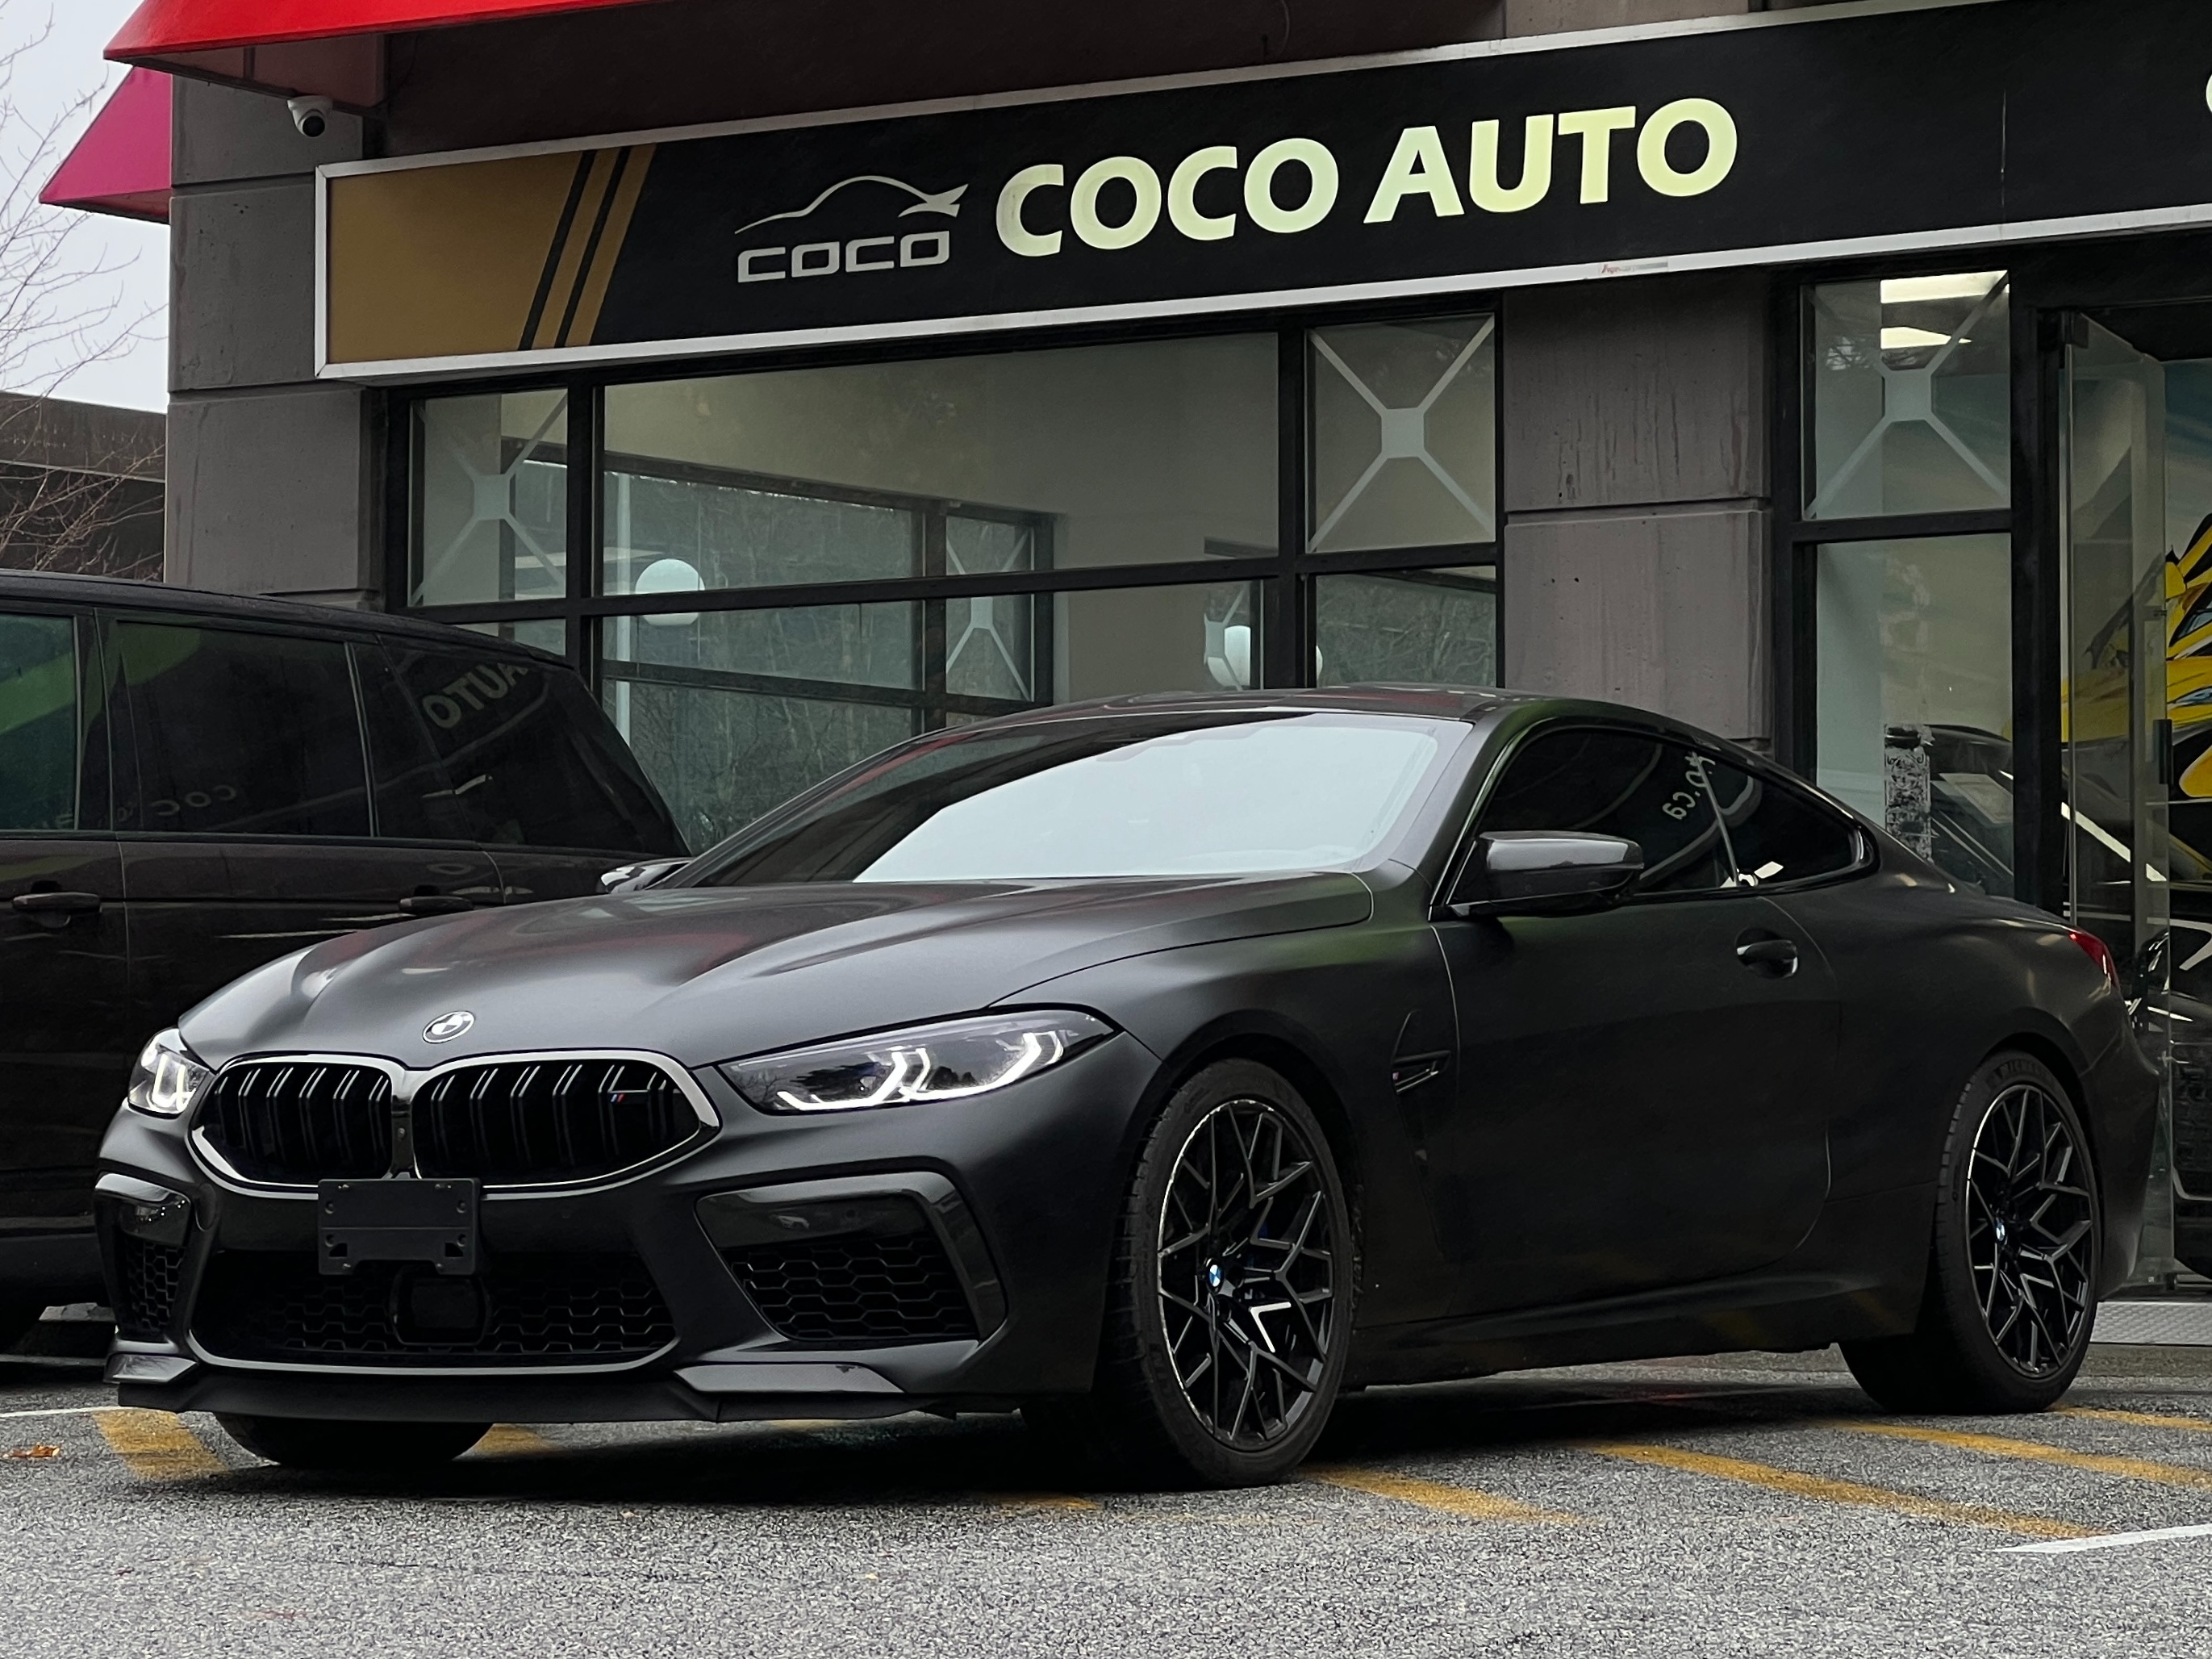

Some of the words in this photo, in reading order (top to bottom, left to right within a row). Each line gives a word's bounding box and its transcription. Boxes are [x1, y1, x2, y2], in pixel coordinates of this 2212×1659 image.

[995, 137, 1339, 257] COCO
[1363, 98, 1738, 224] AUTO
[737, 230, 949, 283] COCO
